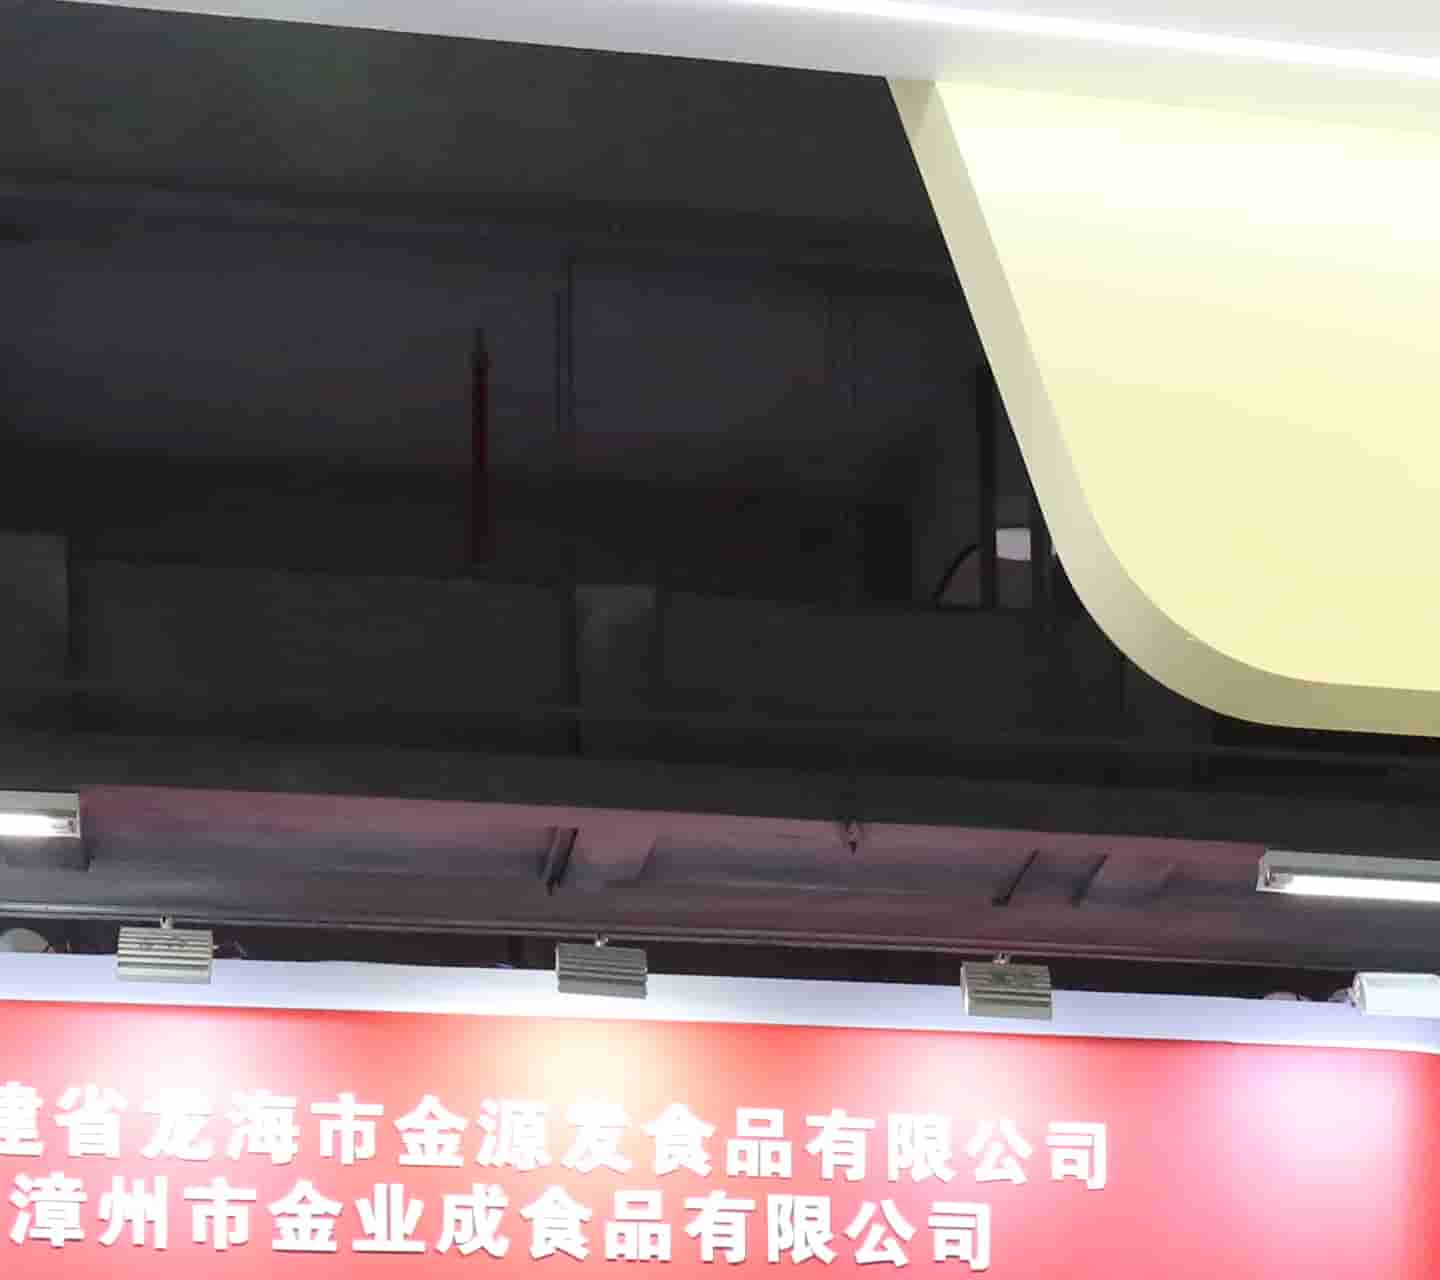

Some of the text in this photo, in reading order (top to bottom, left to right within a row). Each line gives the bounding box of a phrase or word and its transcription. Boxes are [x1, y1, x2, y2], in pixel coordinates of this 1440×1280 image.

[9, 1171, 994, 1272] 漳州市金业成食品有限公司
